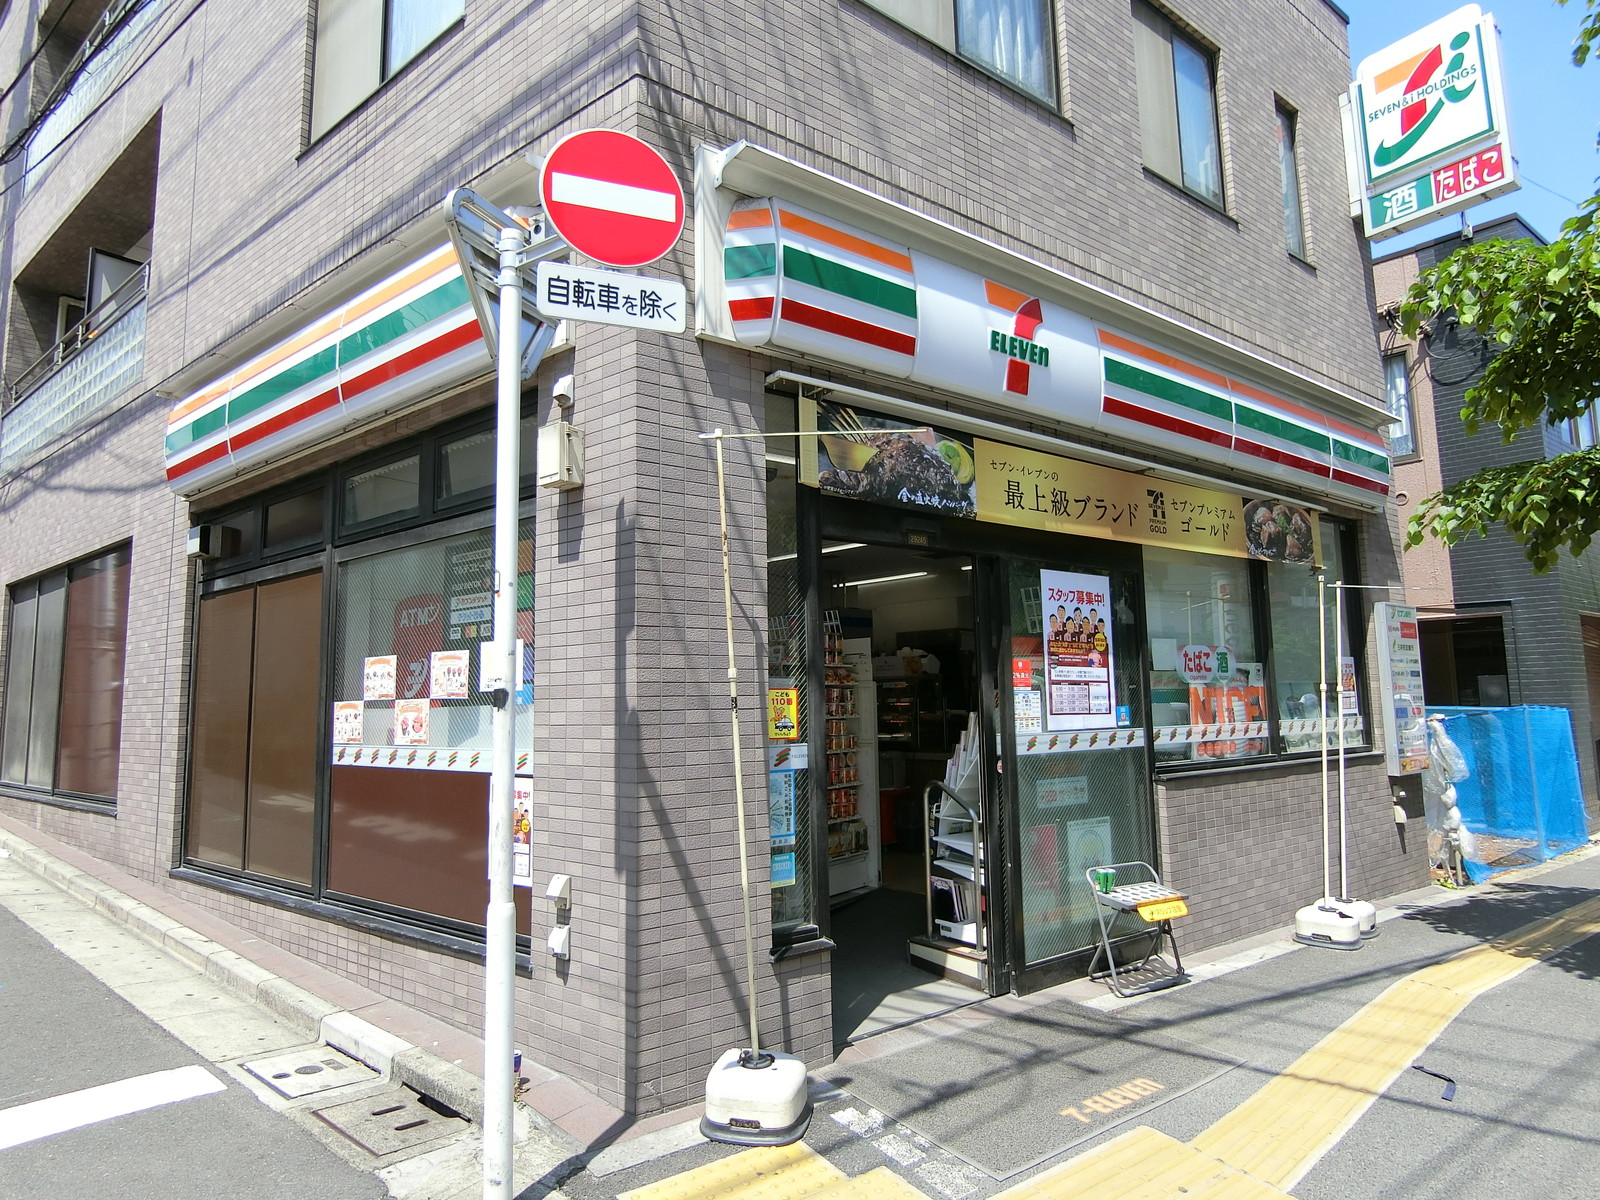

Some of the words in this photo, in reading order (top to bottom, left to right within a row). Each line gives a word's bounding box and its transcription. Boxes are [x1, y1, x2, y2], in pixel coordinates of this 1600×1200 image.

[1416, 63, 1478, 100] HOLDINGS
[1436, 151, 1502, 202] たばこ
[1382, 182, 1418, 223] 酒
[547, 275, 677, 322] 自転車を除く
[1003, 479, 1139, 528] 最上級ブランド
[1170, 498, 1236, 521] セブンプレミアム
[1149, 518, 1167, 526] PREMIUM
[1149, 524, 1168, 535] GOLD
[1180, 517, 1230, 542] ゴールド
[1048, 588, 1105, 607] スタッフ募集中!
[400, 607, 429, 628] ATM
[1183, 650, 1212, 673] たばこ
[1216, 651, 1229, 673] 酒
